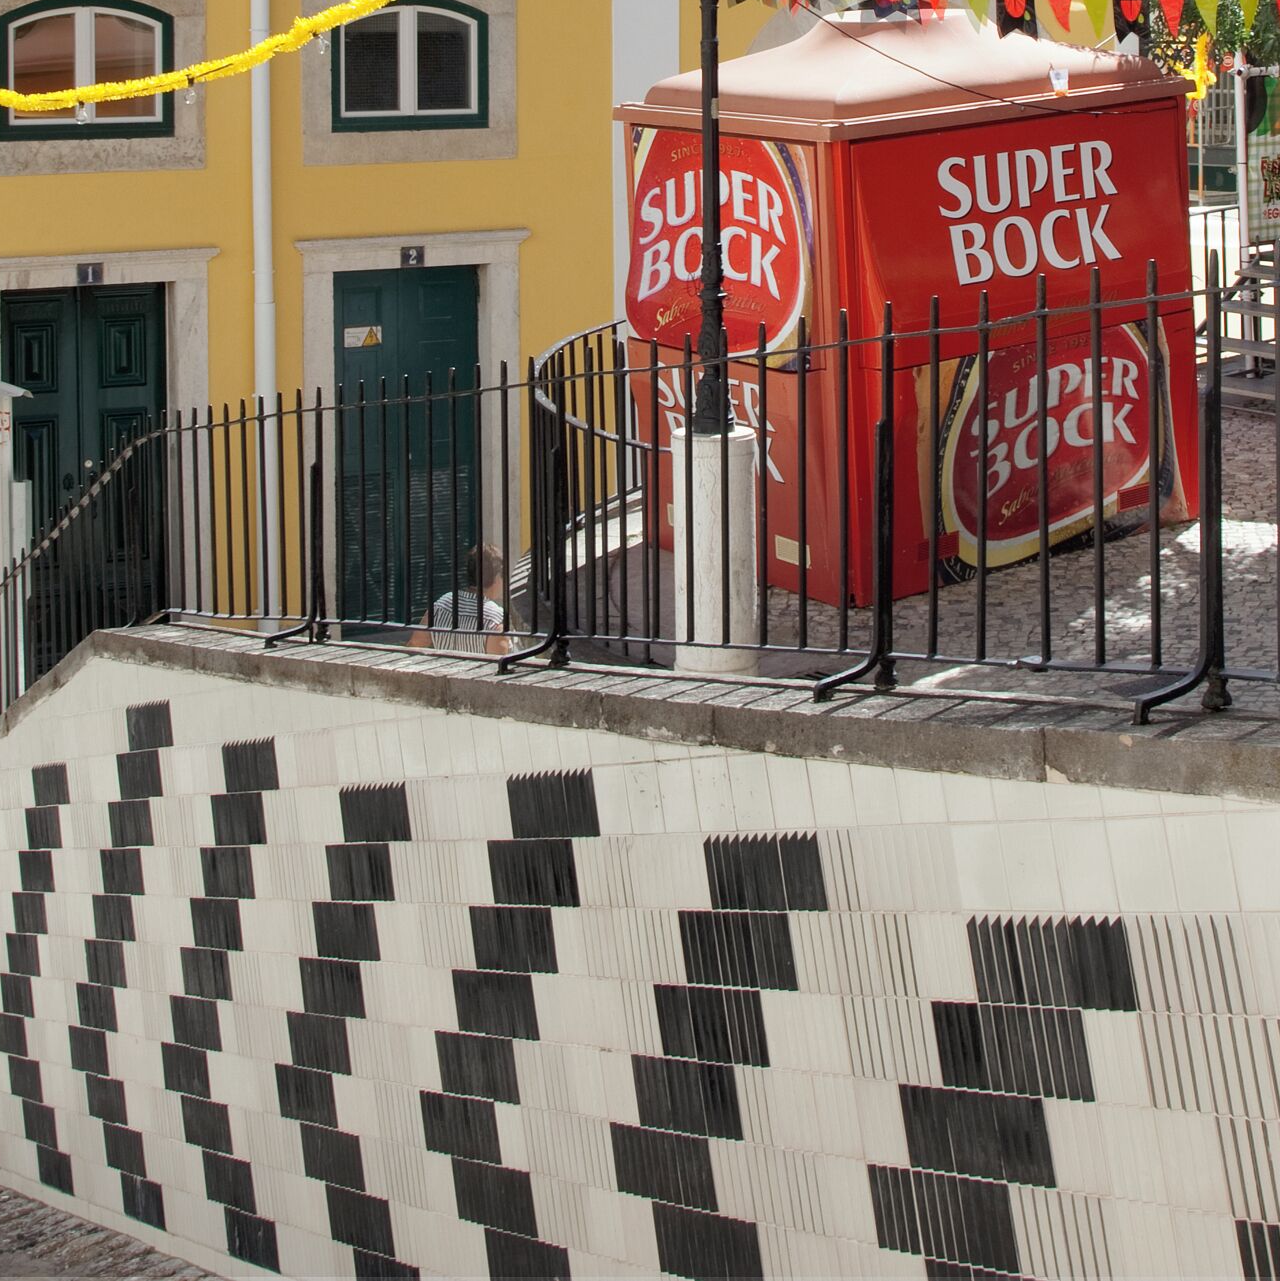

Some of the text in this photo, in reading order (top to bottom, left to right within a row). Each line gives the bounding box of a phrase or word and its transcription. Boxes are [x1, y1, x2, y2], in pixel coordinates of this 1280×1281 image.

[937, 140, 1118, 219] SUPER
[409, 249, 417, 265] 2
[949, 204, 1122, 286] BOCK
